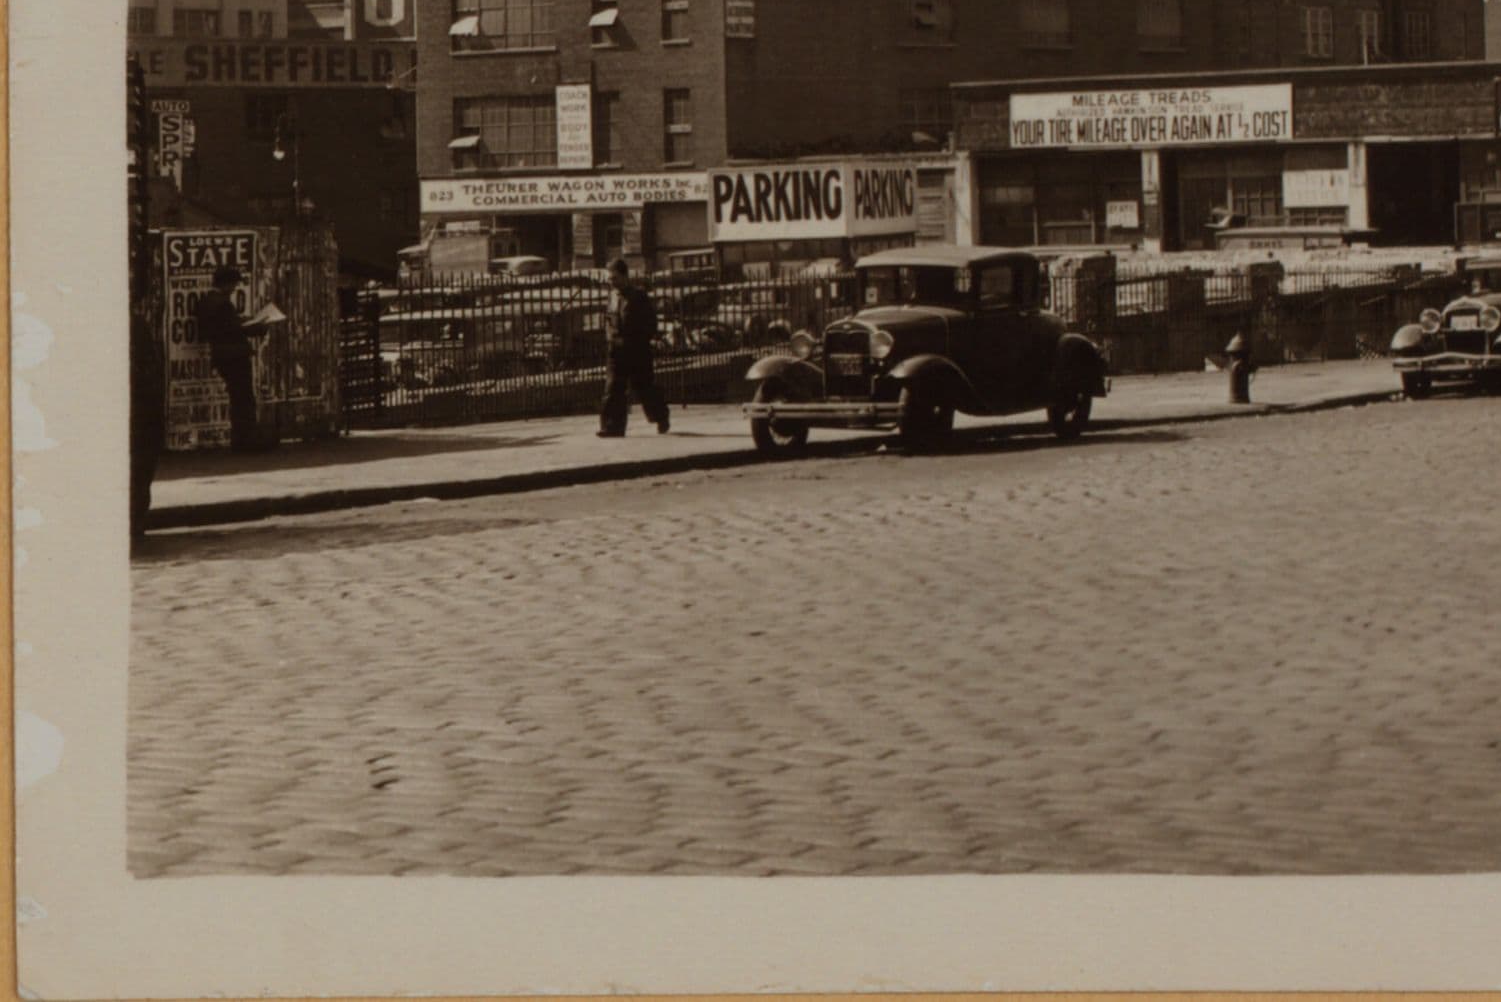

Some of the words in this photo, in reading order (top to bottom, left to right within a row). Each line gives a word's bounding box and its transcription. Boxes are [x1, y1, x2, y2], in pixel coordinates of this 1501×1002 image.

[185, 45, 393, 83] SHEFFIELD
[153, 100, 188, 113] AUTO
[1072, 93, 1140, 107] MILEAGE
[1148, 89, 1212, 105] TREADS
[162, 115, 180, 168] SPR
[1012, 119, 1045, 145] YOUR
[1048, 118, 1073, 144] TIRE
[1076, 116, 1128, 143] MILEAGE
[1131, 115, 1167, 142] OVER
[1171, 113, 1212, 140] AGAIN
[1215, 113, 1234, 139] AT
[1253, 110, 1289, 138] COST
[463, 181, 539, 195] THEURER
[547, 180, 605, 193] WAGON
[612, 178, 672, 191] WORKS
[472, 192, 577, 207] COMMERCIAL
[586, 192, 627, 204] AUTO
[632, 189, 687, 202] BODIES
[713, 169, 842, 224] PARKING
[854, 167, 914, 219] PARKING
[169, 237, 249, 267] STATE
